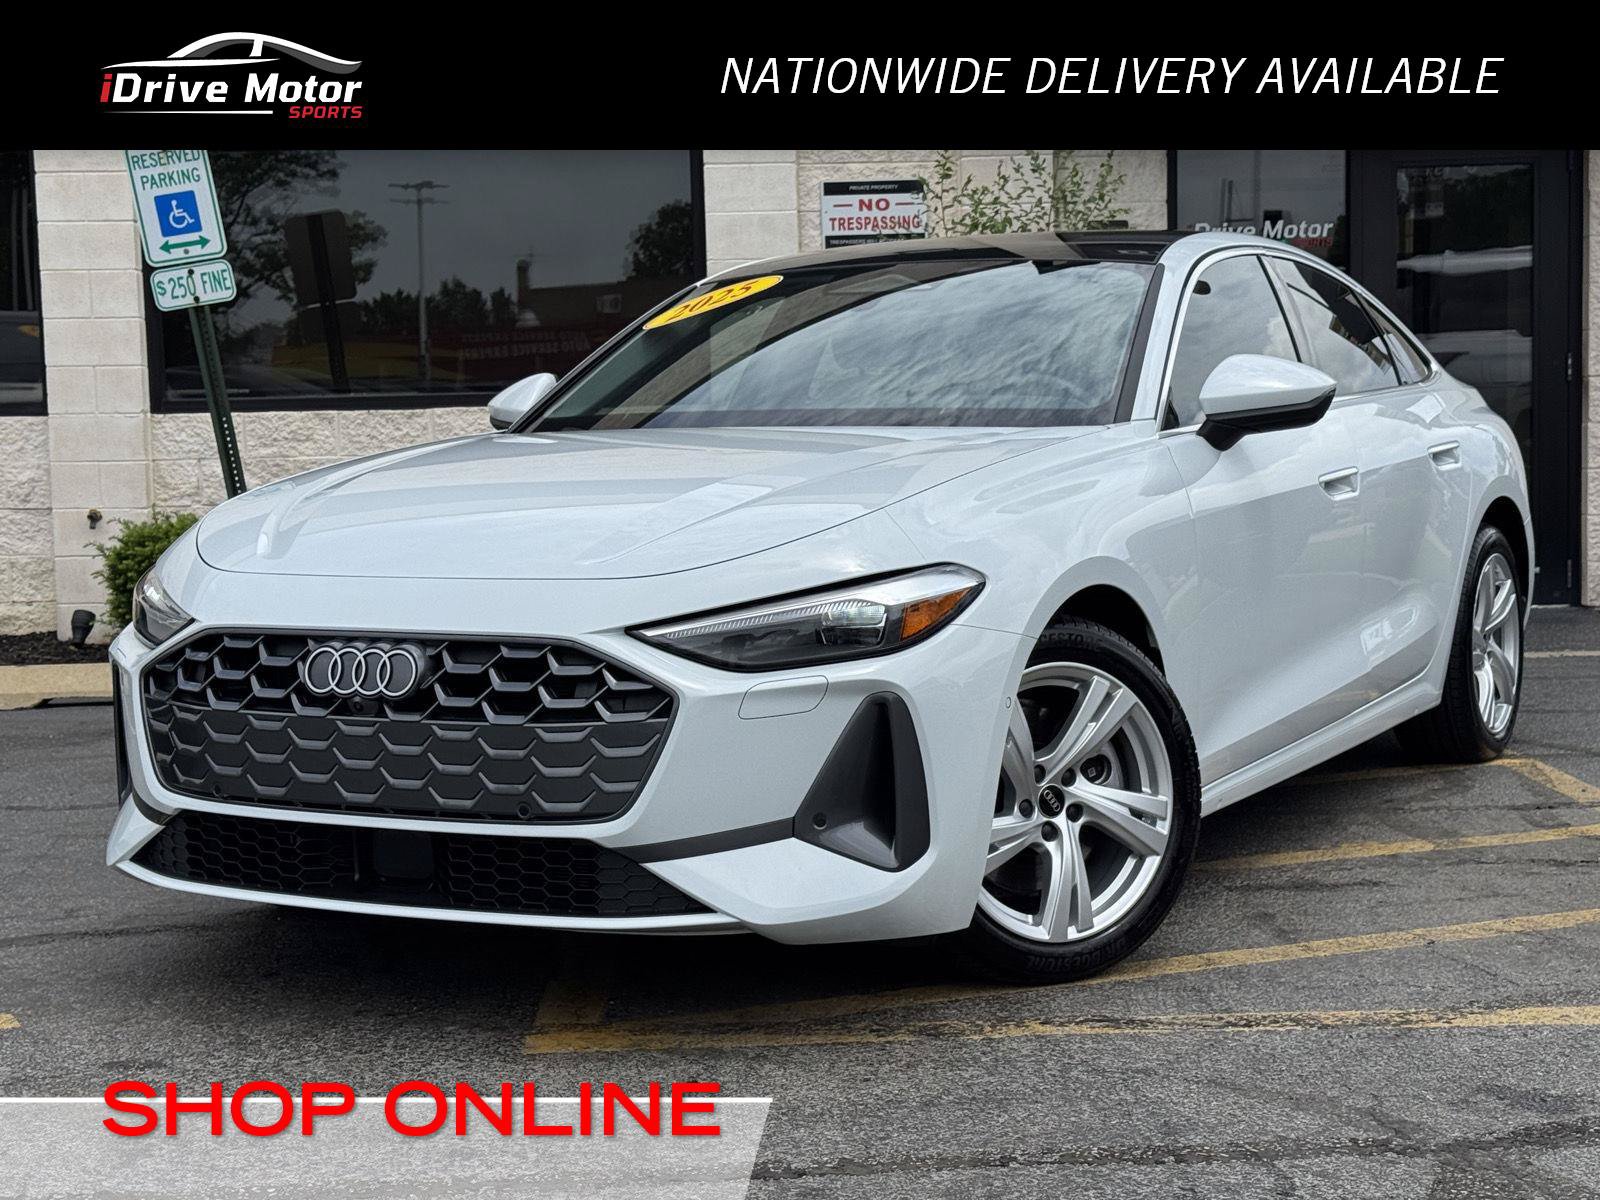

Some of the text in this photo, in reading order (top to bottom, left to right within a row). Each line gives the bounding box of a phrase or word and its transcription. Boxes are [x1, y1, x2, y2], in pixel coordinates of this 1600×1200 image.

[131, 149, 201, 170] RESERVED
[140, 167, 201, 191] PARKING
[870, 183, 898, 191] PROPERTY
[858, 197, 890, 212] NO
[829, 214, 921, 232] TRESPASSING
[1262, 219, 1334, 239] Motor
[156, 268, 232, 300] $250 FINE
[664, 280, 759, 323] 2025
